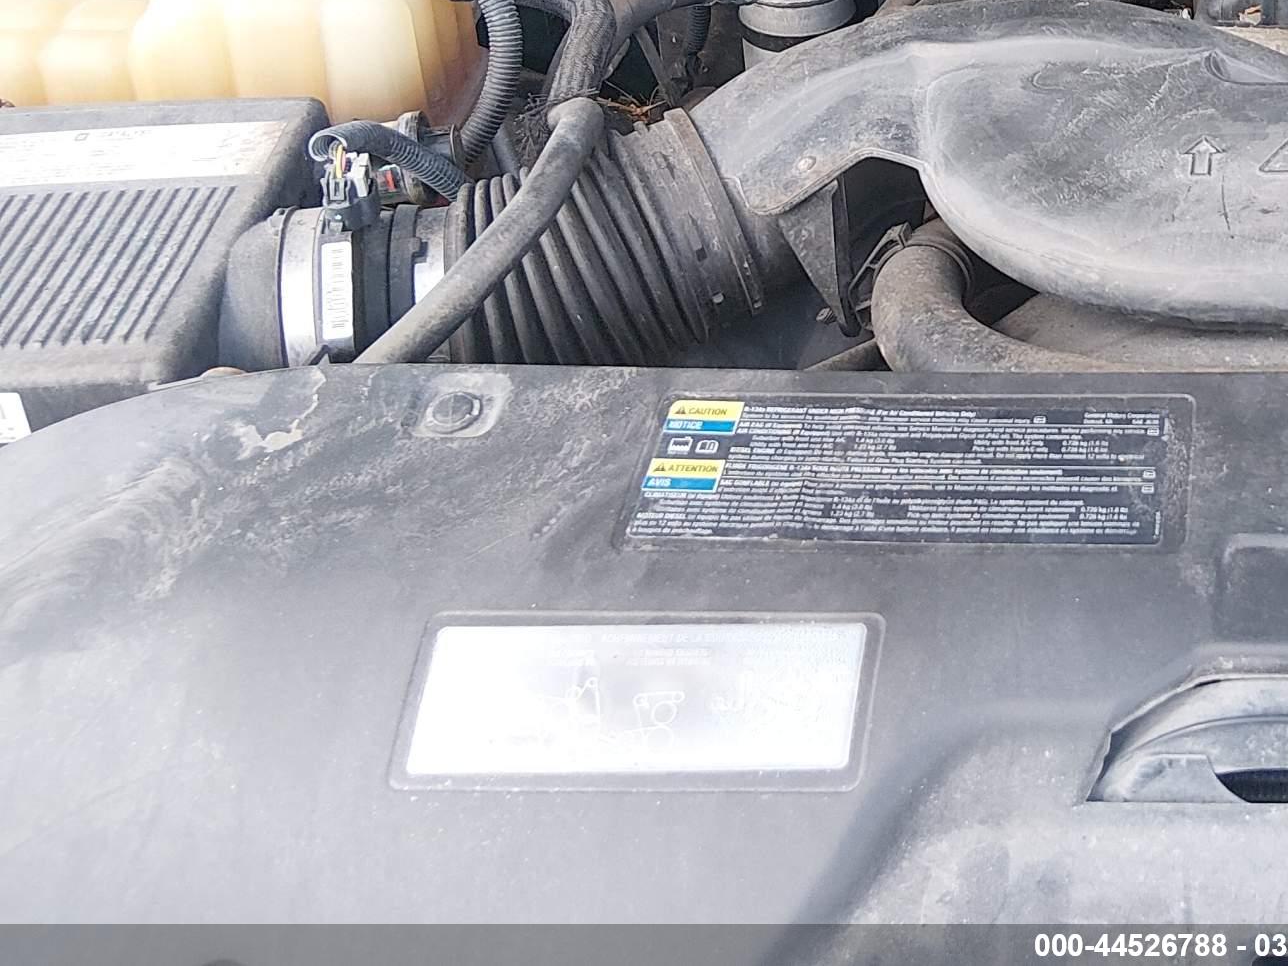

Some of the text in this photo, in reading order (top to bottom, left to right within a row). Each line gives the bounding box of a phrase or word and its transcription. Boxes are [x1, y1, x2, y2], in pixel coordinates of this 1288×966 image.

[668, 421, 703, 429] NOTICE
[668, 464, 718, 472] ATTENTION
[646, 479, 671, 487] AVIS
